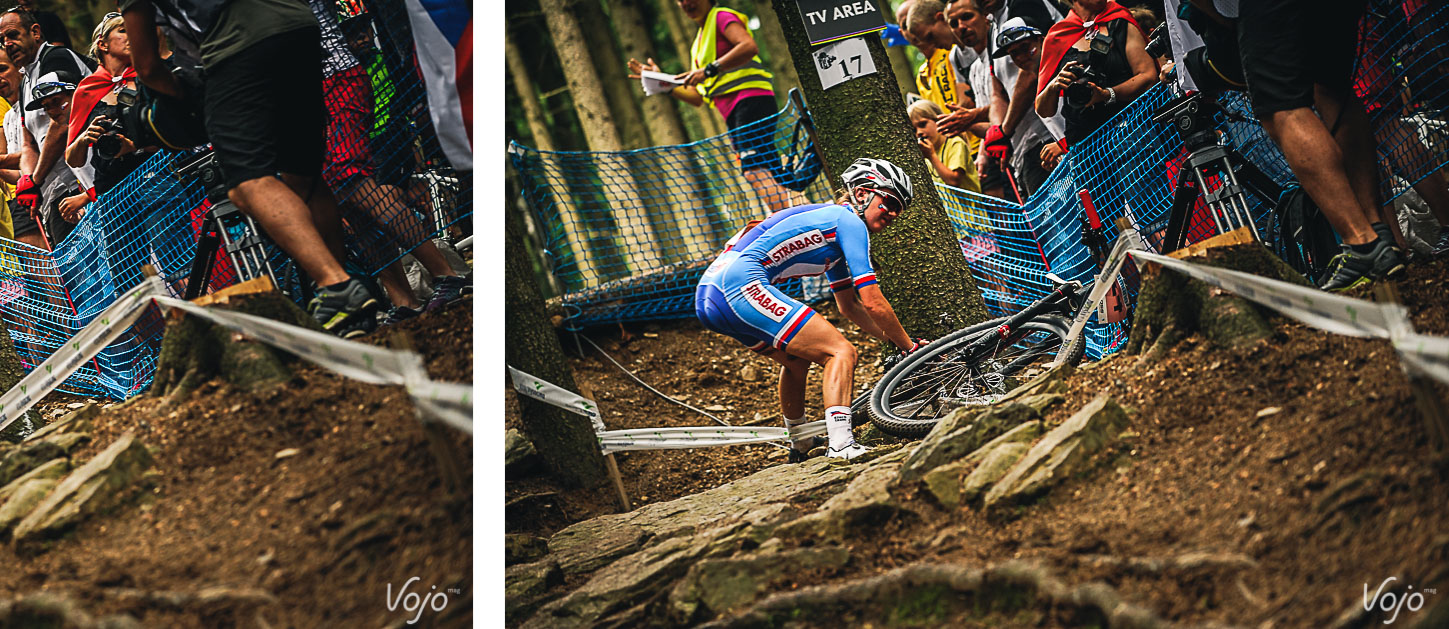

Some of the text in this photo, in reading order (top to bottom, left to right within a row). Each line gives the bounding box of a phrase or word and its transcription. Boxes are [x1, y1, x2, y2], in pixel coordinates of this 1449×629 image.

[806, 0, 876, 25] TV AREA
[838, 55, 862, 78] 17
[772, 233, 823, 263] STRABAG
[746, 283, 787, 317] STRABAG
